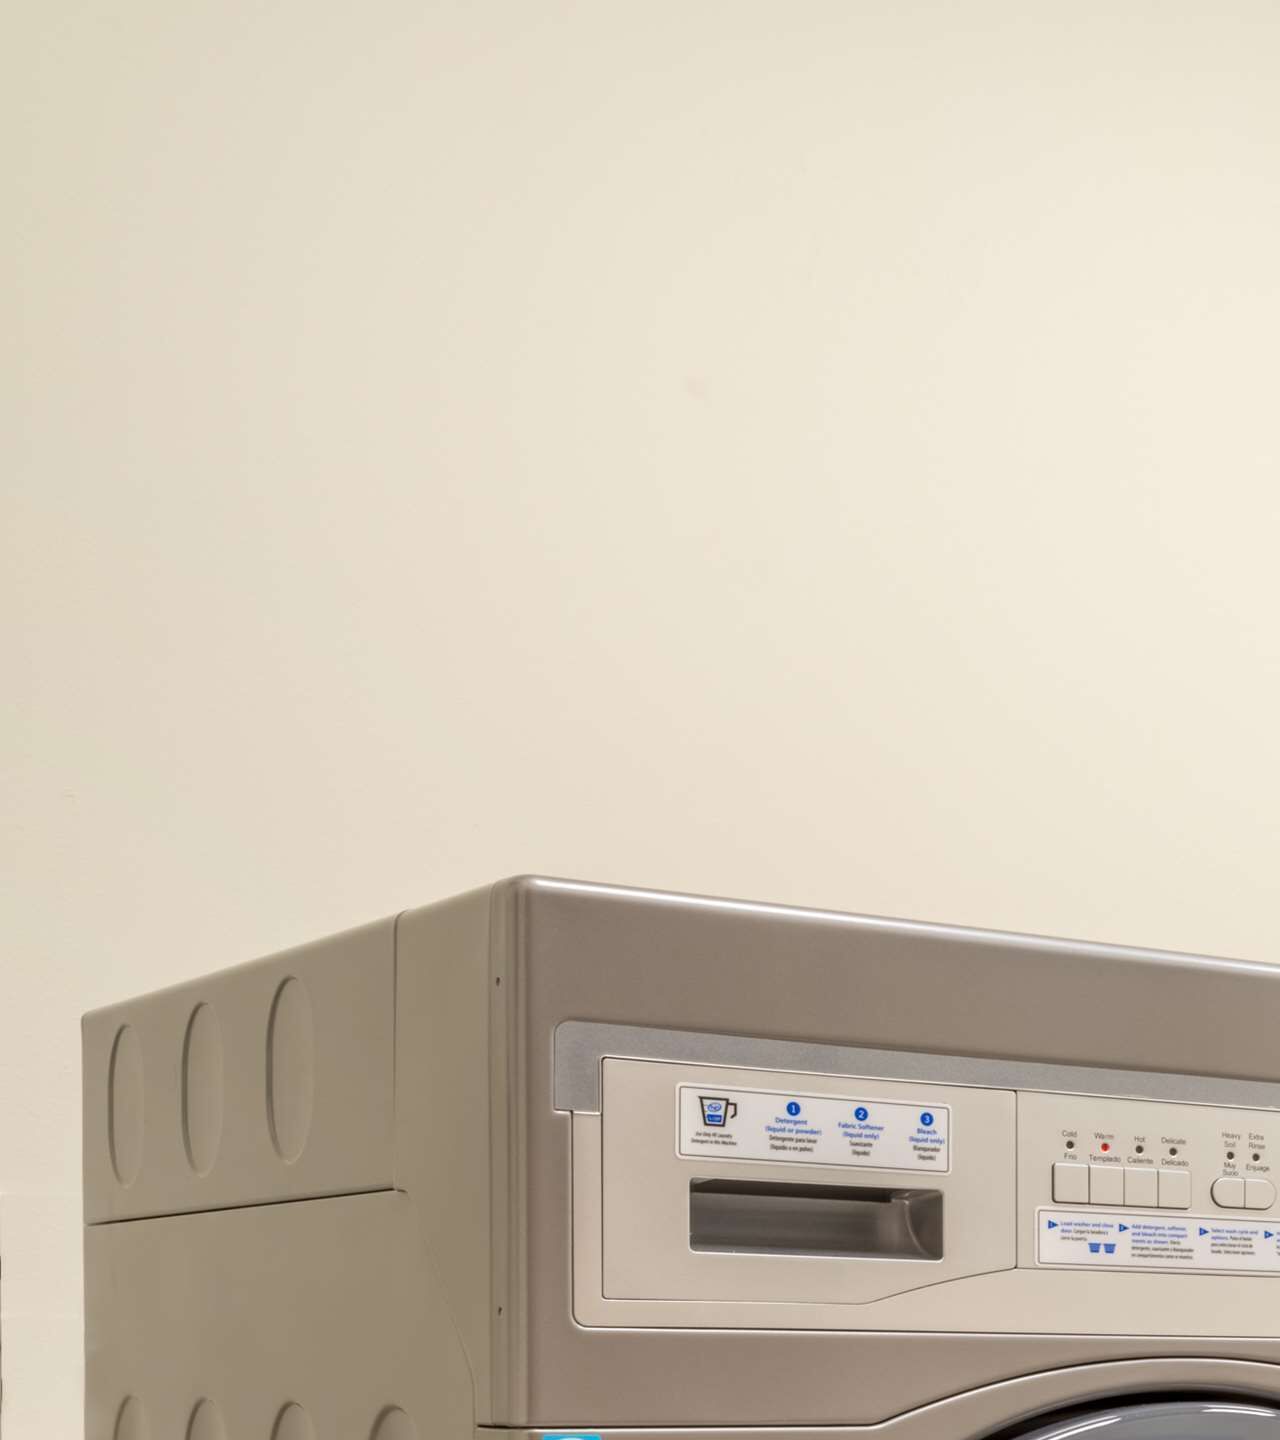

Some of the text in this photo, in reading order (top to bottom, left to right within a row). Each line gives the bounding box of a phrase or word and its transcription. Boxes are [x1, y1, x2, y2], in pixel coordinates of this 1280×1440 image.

[775, 1117, 808, 1126] Detergent
[858, 1123, 884, 1131] Softener
[1062, 1130, 1077, 1138] Cold
[1222, 1132, 1241, 1140] Heavy
[1249, 1133, 1265, 1141] Extra
[1161, 1137, 1186, 1145] Delicate
[1249, 1142, 1265, 1150] Rinse
[1089, 1154, 1121, 1163] Templado
[1127, 1156, 1154, 1164] Caliente
[1161, 1158, 1190, 1167] Delicado
